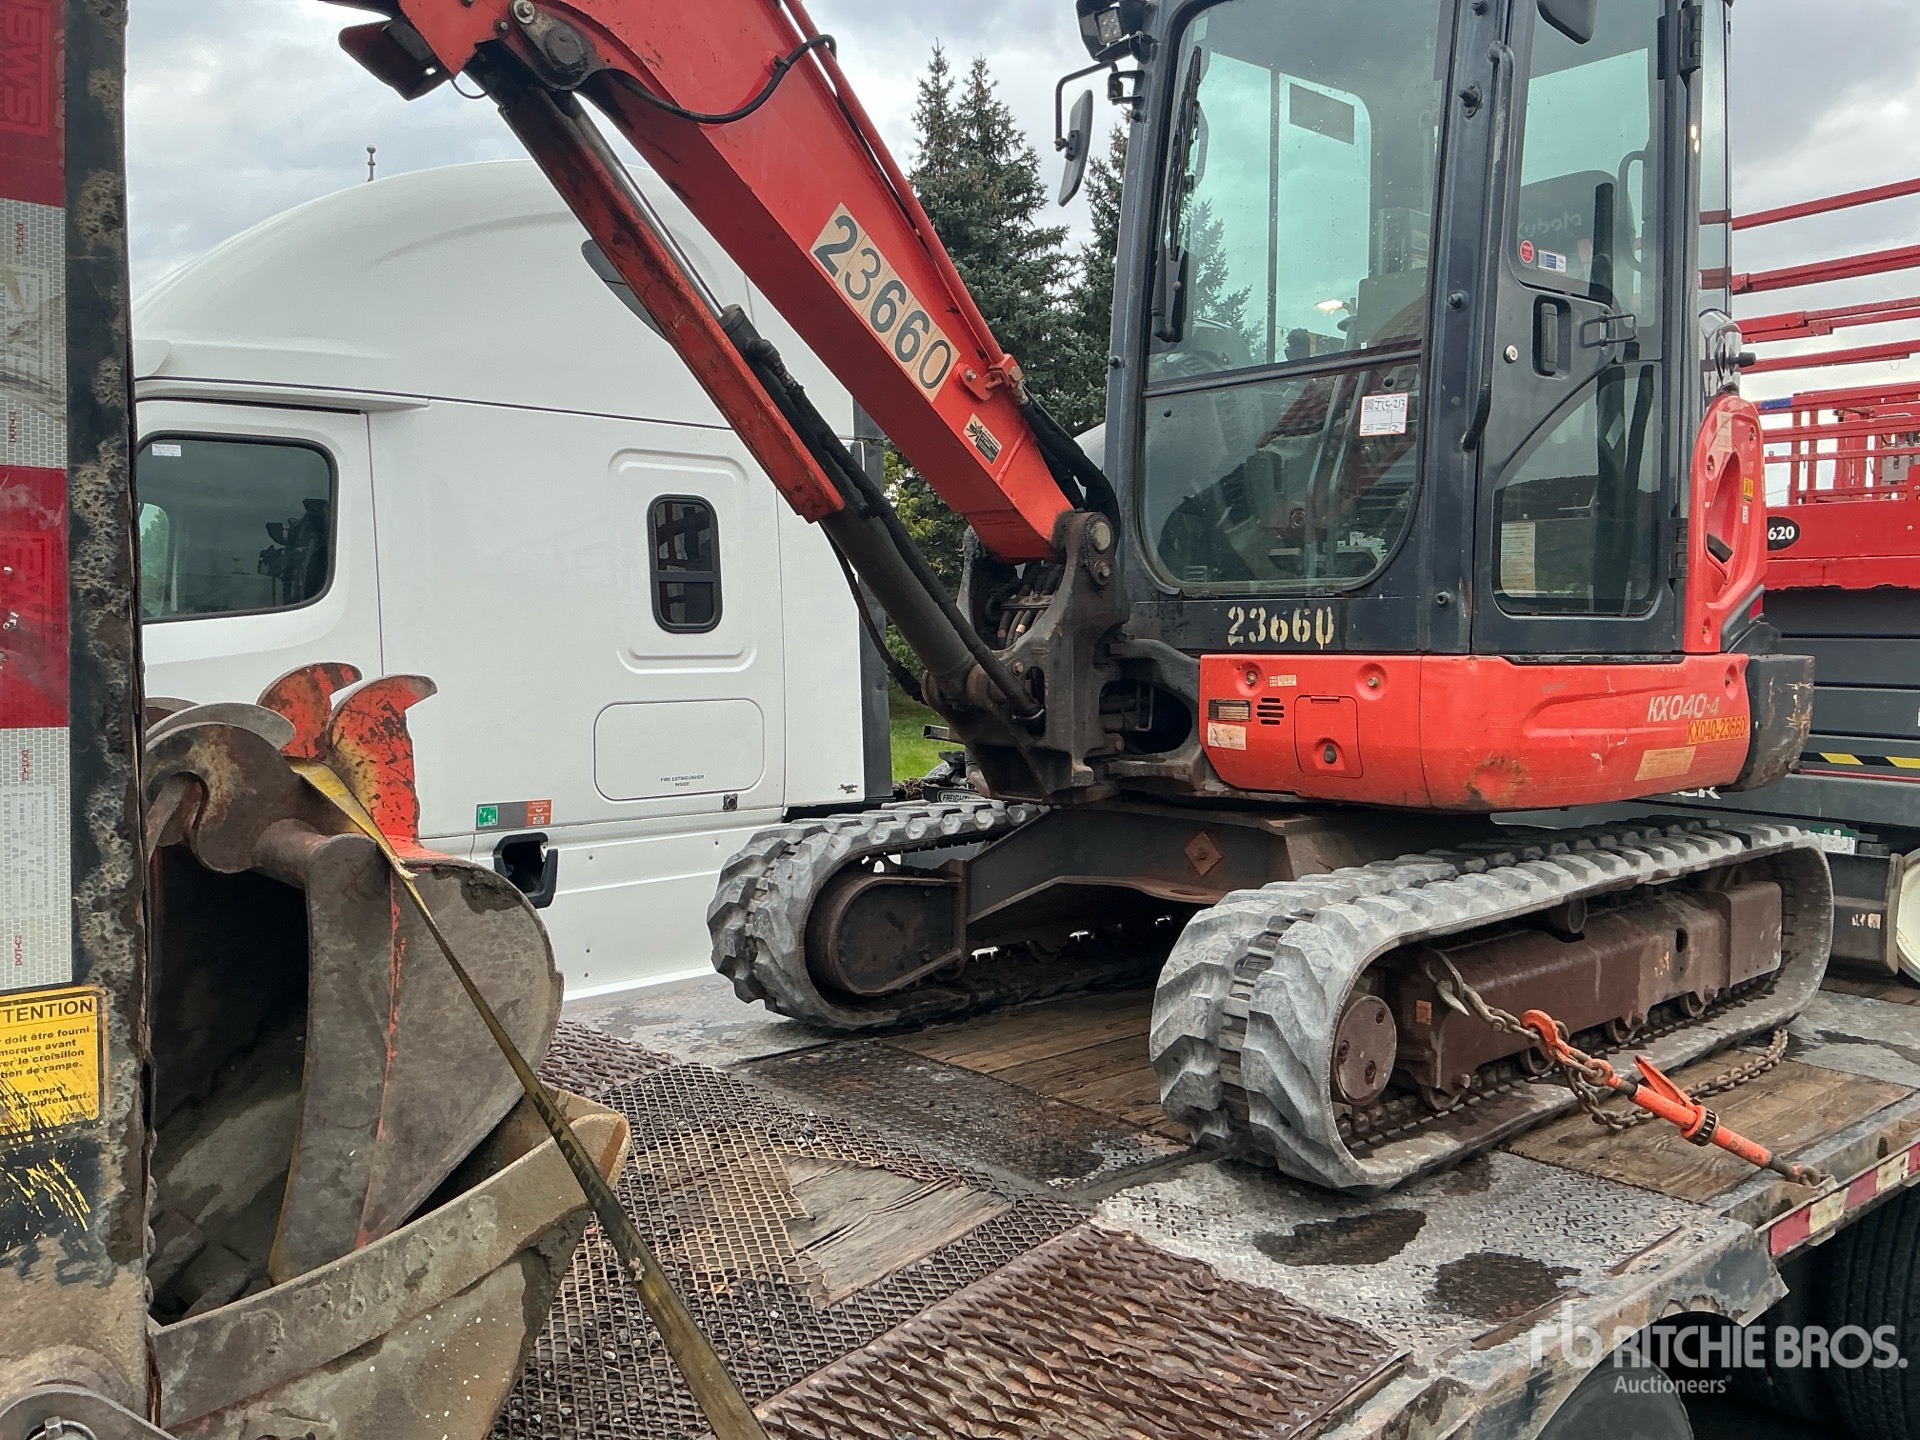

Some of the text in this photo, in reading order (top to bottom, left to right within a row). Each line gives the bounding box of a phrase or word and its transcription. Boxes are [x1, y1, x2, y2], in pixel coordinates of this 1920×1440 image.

[814, 215, 951, 390] 23660
[1767, 525, 1796, 541] 620
[1227, 606, 1335, 650] 23660
[1647, 693, 1720, 722] KX040-4
[1687, 716, 1746, 743] KX040-23660
[14, 934, 23, 967] DOT-C2
[0, 999, 93, 1023] TENTION
[5, 1026, 90, 1045] doit être fourni
[45, 1039, 77, 1050] avant
[18, 1057, 29, 1065] le
[32, 1050, 85, 1063] croisillon
[26, 1067, 40, 1075] de
[44, 1061, 82, 1073] rampe.
